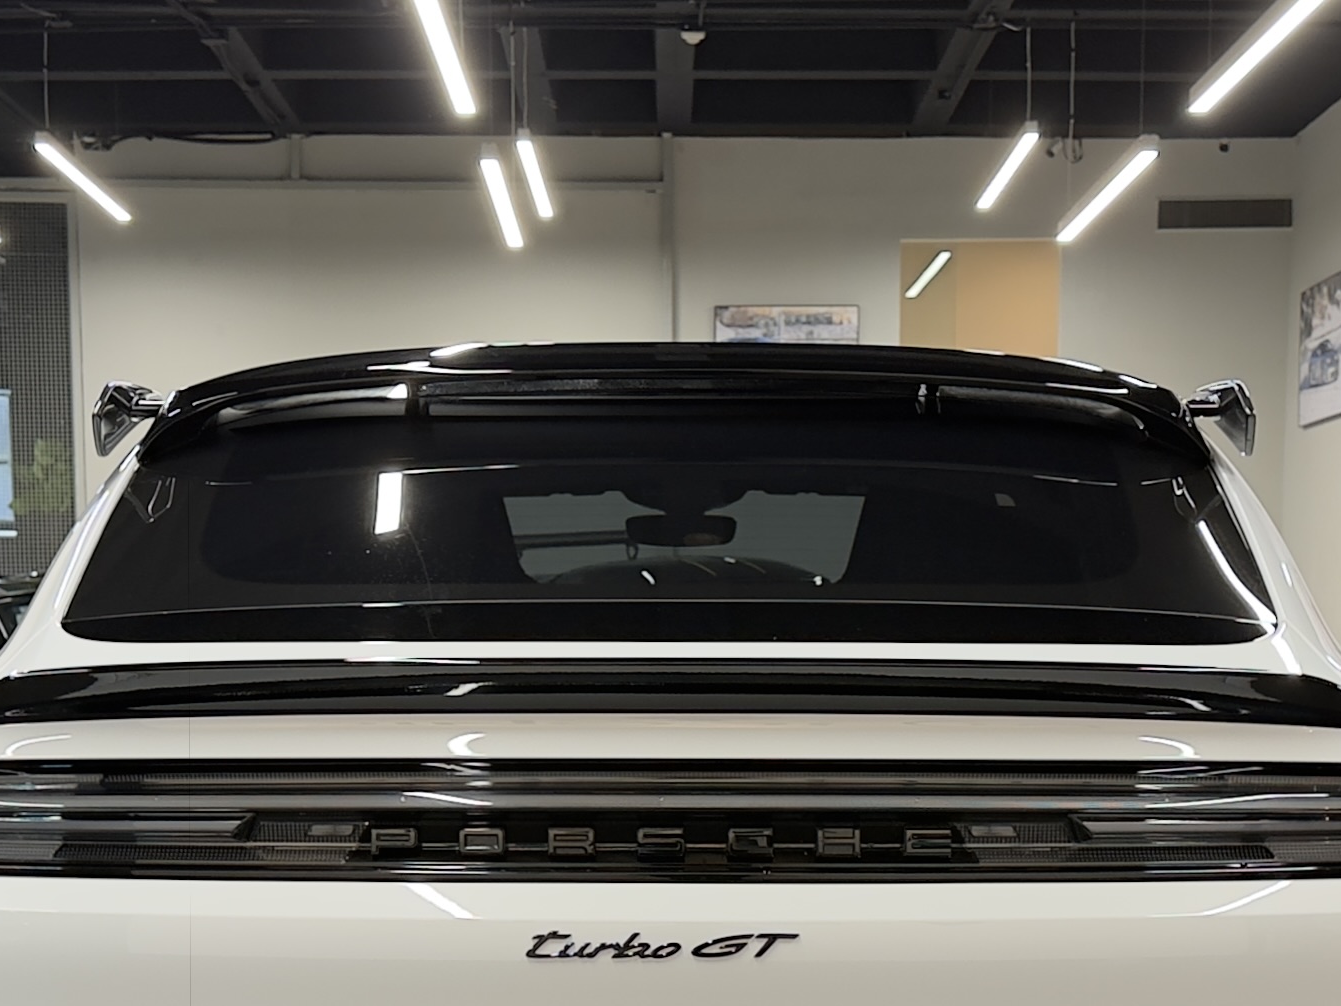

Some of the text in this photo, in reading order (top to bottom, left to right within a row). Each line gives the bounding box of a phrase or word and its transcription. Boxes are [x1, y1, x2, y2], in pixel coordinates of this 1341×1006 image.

[370, 826, 952, 858] PORSCHE
[525, 930, 800, 959] turbo GT
